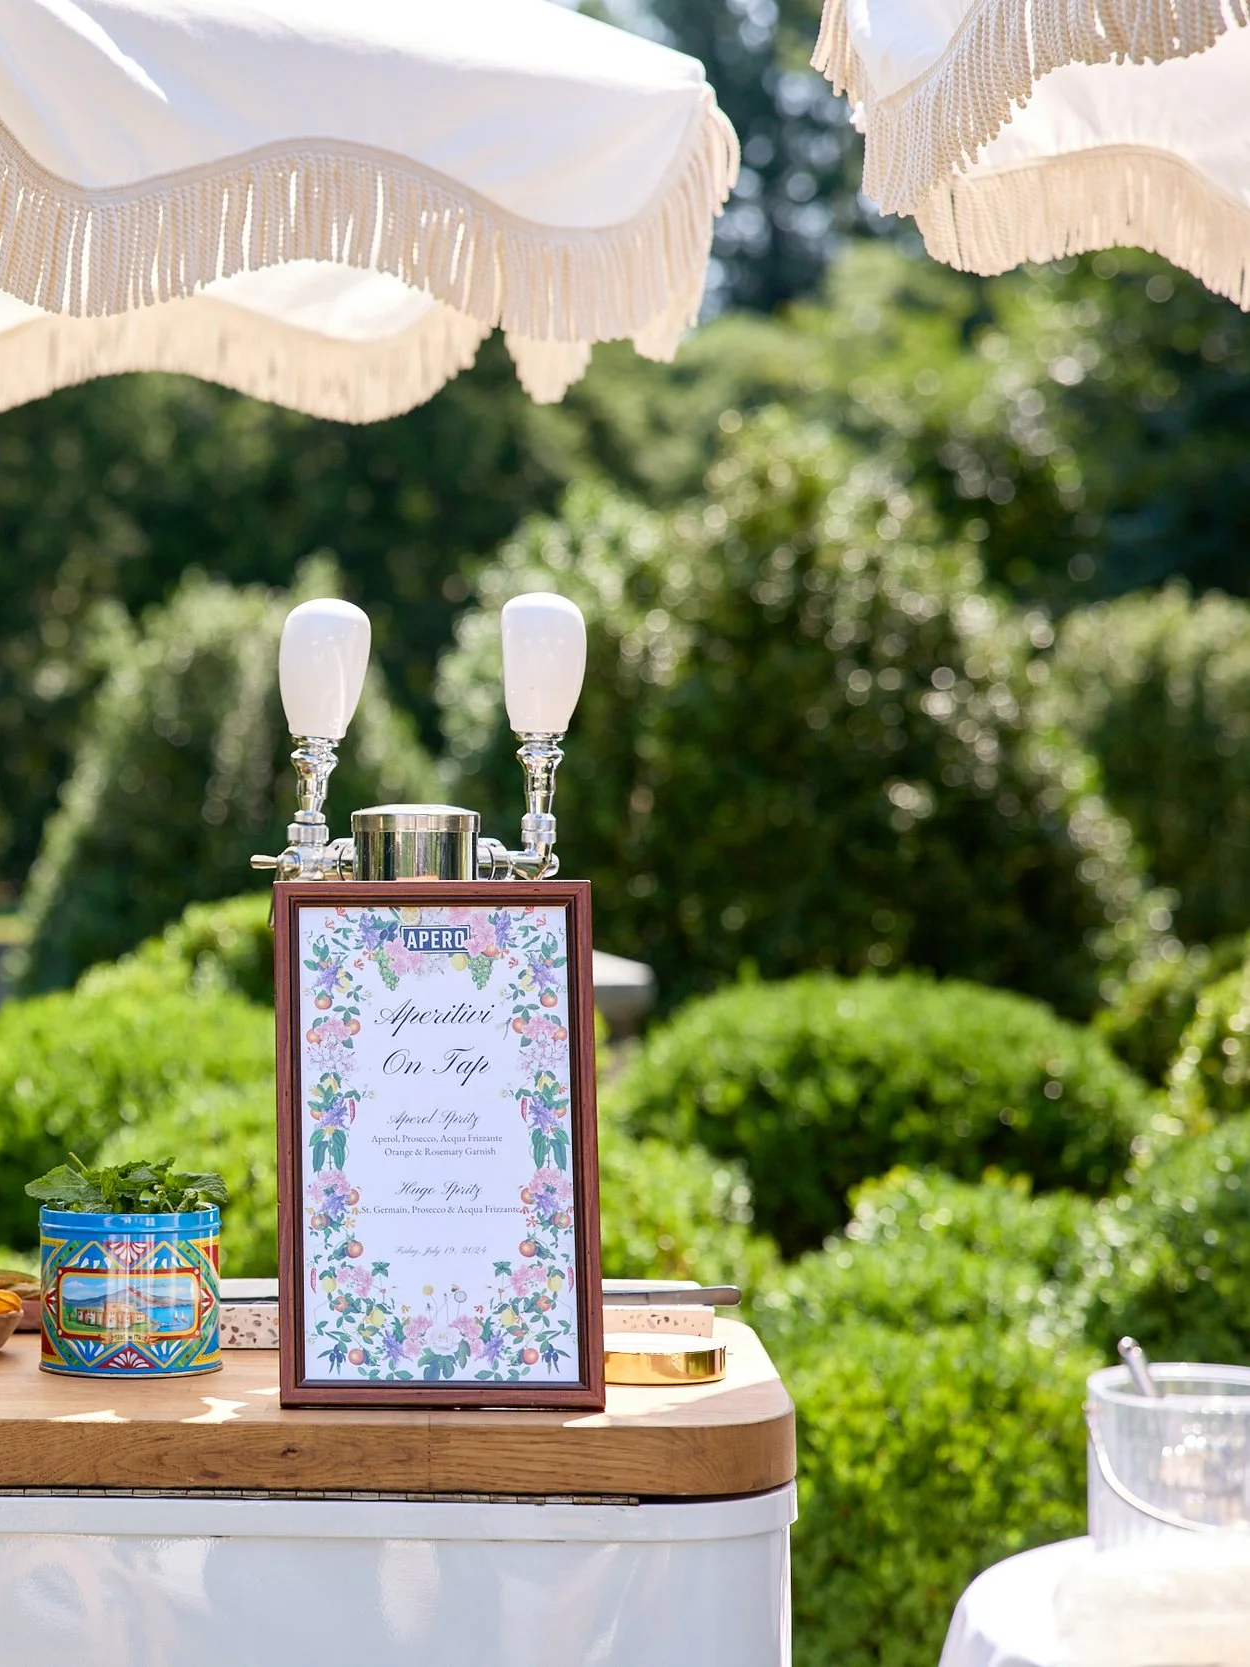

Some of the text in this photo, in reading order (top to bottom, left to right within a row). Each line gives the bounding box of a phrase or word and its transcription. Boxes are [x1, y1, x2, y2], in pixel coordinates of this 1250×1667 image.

[406, 930, 465, 949] APERO
[374, 998, 495, 1037] Aperitivi
[383, 1046, 491, 1086] On Tap
[387, 1108, 480, 1130] Aperol Spritz
[440, 1134, 466, 1145] Acqua
[468, 1134, 503, 1142] Frizzante
[384, 1146, 496, 1158] Orange & Rosemary Garnish
[395, 1181, 482, 1201] Hugo Spritz
[411, 1205, 446, 1214] Prosecco
[447, 1206, 455, 1214] &
[458, 1205, 483, 1216] Acqua
[485, 1204, 520, 1213] Frizzante
[421, 1245, 441, 1257] July
[462, 1246, 487, 1254] 2024
